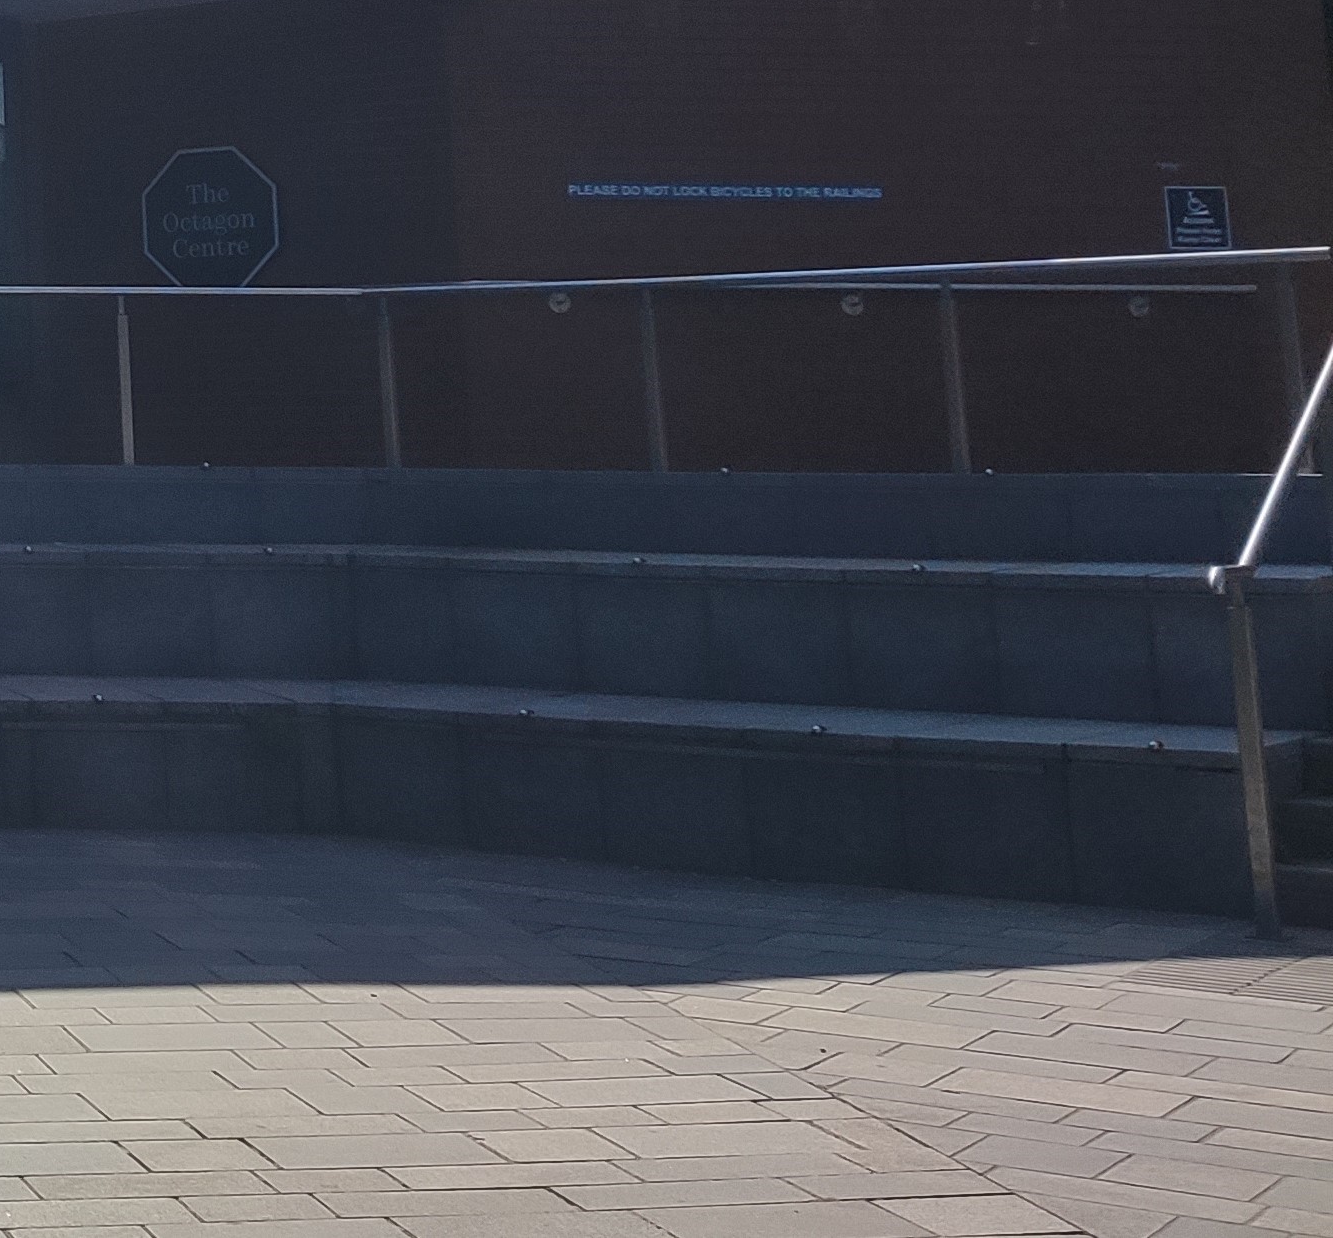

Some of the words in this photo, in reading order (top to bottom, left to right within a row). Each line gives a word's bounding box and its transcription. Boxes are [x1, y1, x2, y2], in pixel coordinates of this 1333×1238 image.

[186, 183, 230, 205] The
[568, 184, 618, 196] PLEASE
[621, 185, 641, 196] DO
[643, 185, 670, 196] NOT
[673, 186, 708, 196] LOCK
[710, 186, 773, 197] BICYCLES
[775, 186, 794, 198] TO
[795, 187, 821, 198] THE
[823, 187, 882, 199] RAILINGS
[162, 212, 256, 235] Octagon
[172, 238, 249, 258] Centre
